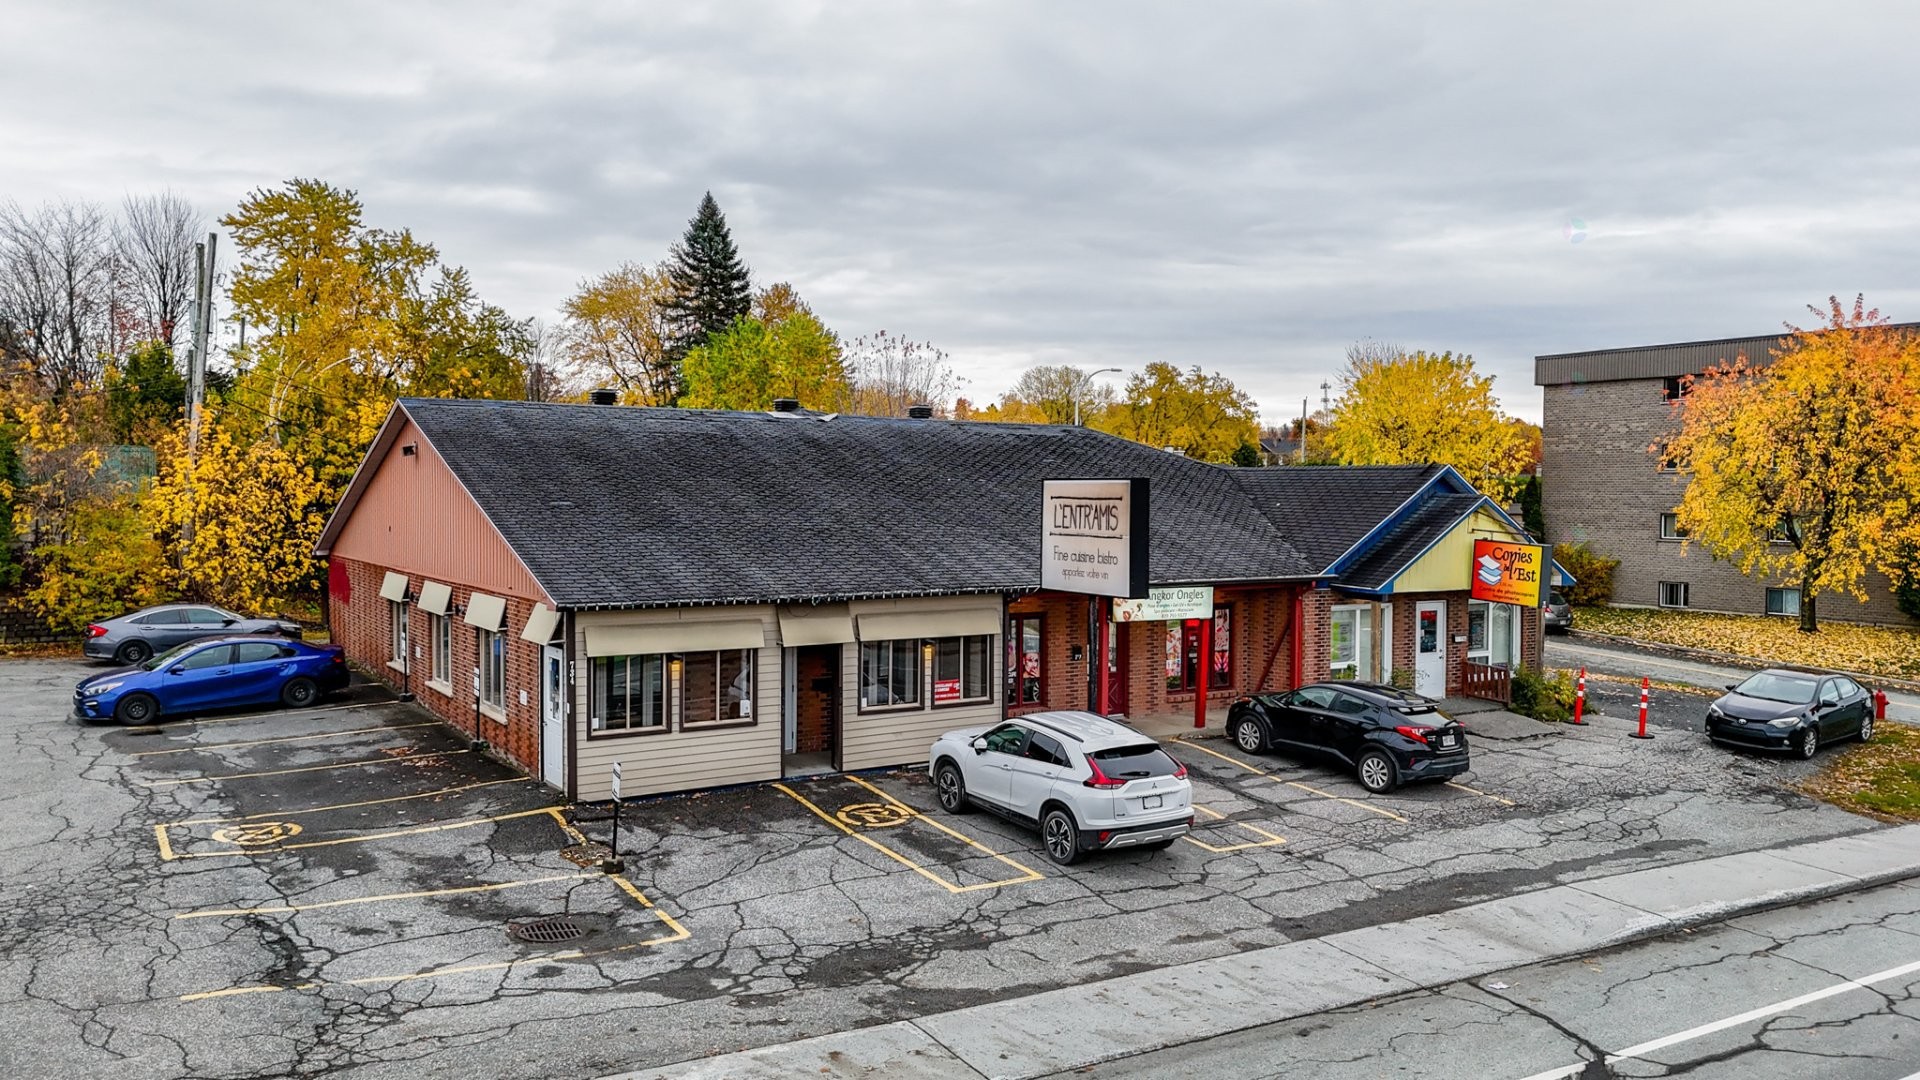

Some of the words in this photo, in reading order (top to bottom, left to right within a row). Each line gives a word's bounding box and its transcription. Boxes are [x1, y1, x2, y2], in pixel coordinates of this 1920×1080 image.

[1054, 504, 1119, 531] L'ENTR'AMIS
[1053, 545, 1069, 561] Fine
[1070, 551, 1095, 564] cuisine
[1097, 547, 1118, 565] bistro
[1492, 547, 1533, 567] Copies
[1176, 589, 1204, 602] Ongles
